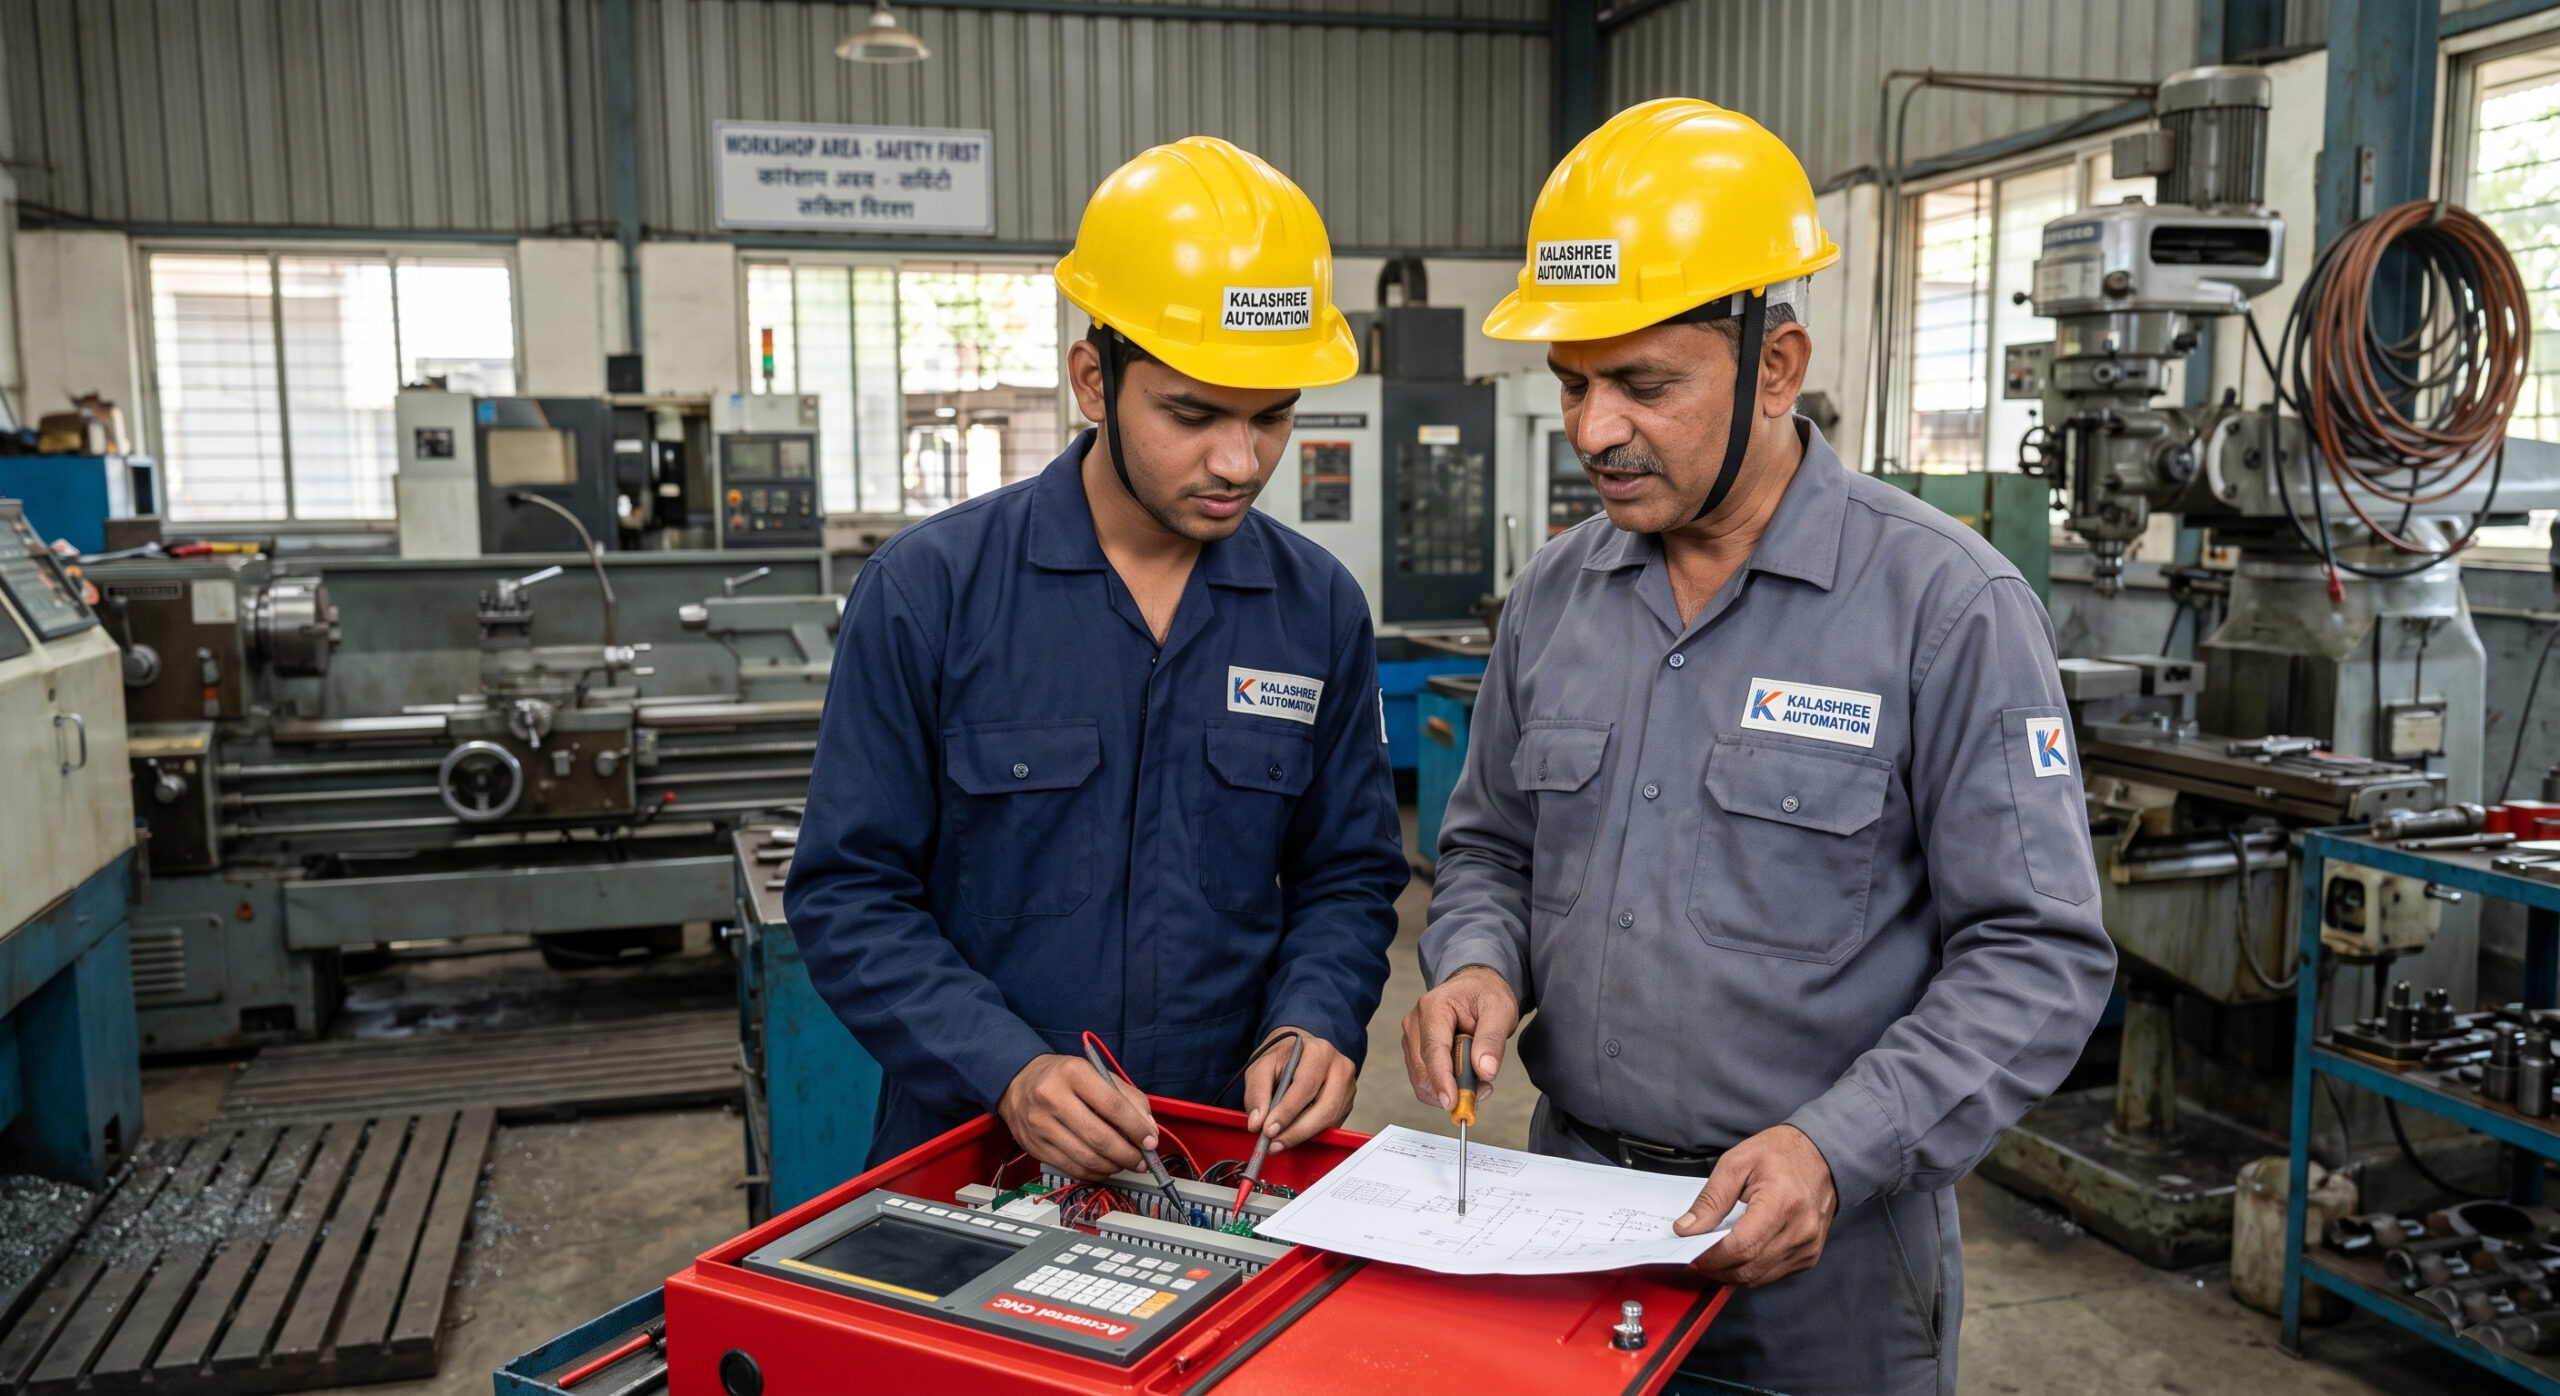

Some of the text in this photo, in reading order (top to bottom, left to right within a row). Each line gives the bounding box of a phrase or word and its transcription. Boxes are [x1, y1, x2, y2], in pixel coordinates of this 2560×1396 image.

[725, 135, 816, 157] WORKSHOP
[820, 137, 861, 159] AREA
[874, 139, 933, 161] SAFETY
[937, 141, 981, 163] FIRST
[1540, 244, 1612, 261] KALASHREE
[1538, 264, 1616, 280] AUTOMATION
[1230, 292, 1307, 307] KALASHREE
[1225, 310, 1309, 326] AUTOMATION
[1260, 681, 1317, 701] KALASHREE
[1260, 695, 1316, 714] AUTOMATION
[1787, 694, 1872, 719] KALASHREE
[1782, 710, 1871, 735] AUTOMATION
